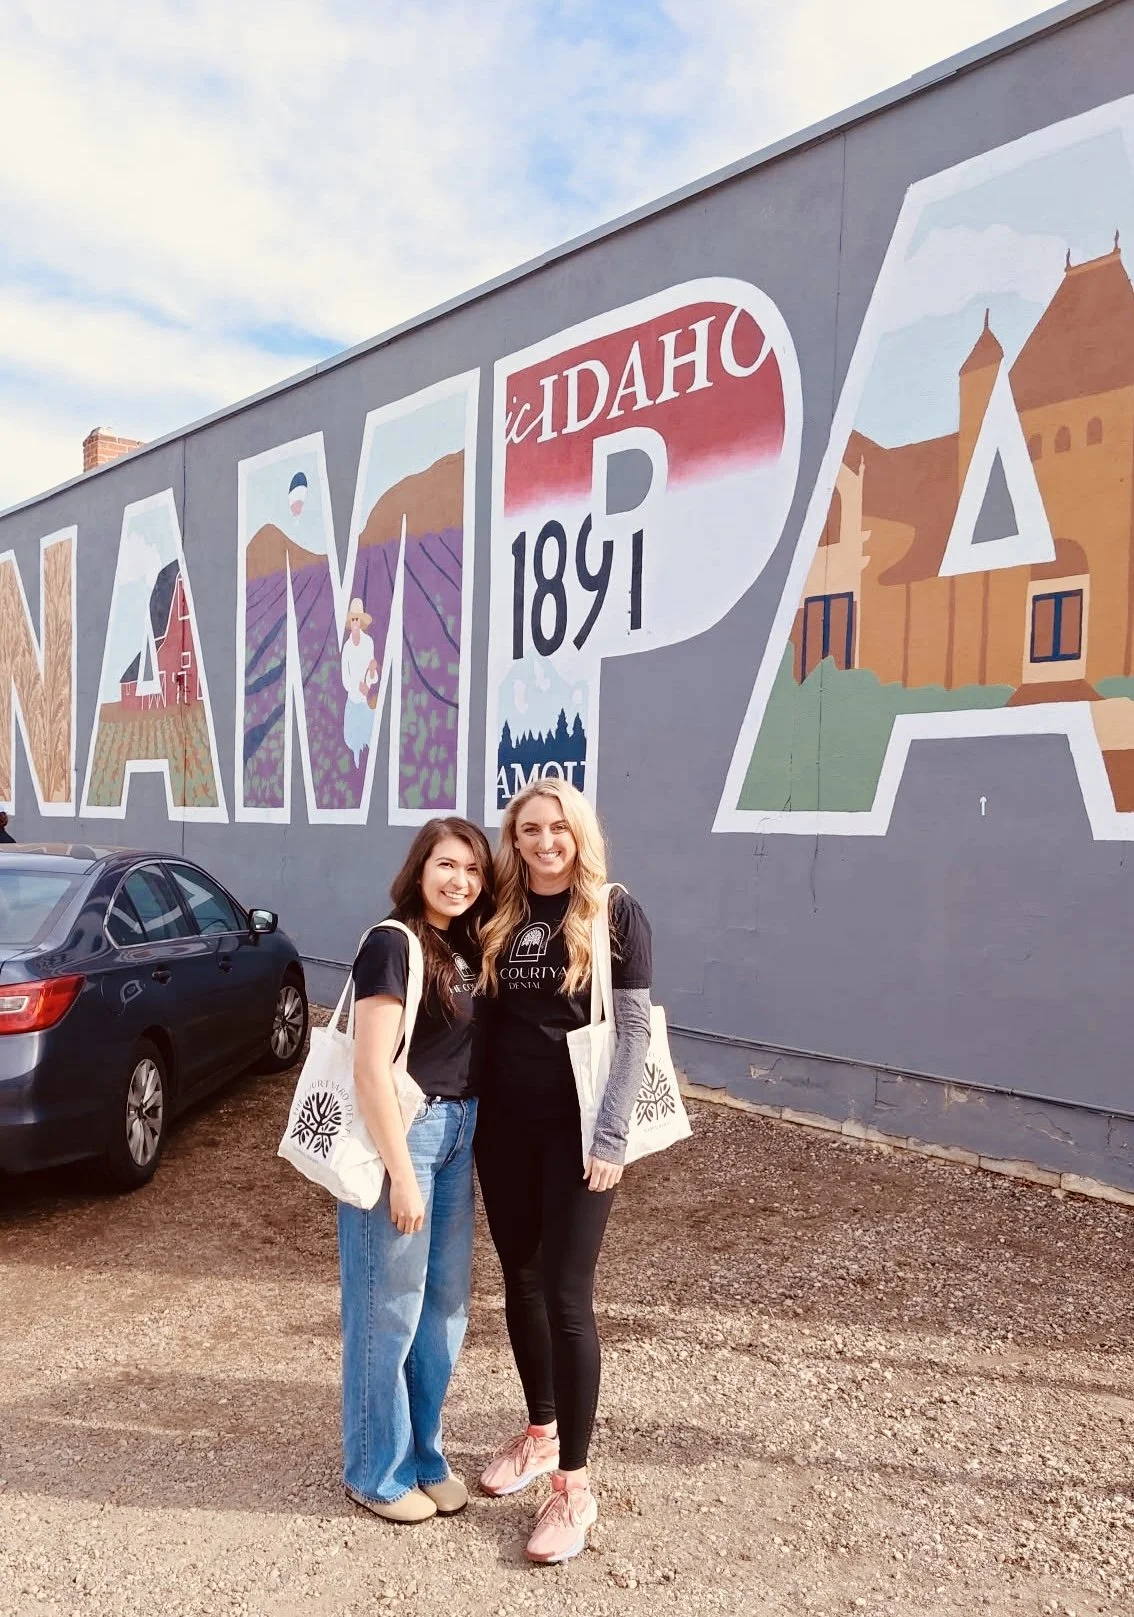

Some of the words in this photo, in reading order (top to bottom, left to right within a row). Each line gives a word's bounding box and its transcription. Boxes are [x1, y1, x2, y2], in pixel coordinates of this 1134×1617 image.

[537, 306, 773, 443] IDAHO
[0, 95, 1134, 841] NAMPA
[511, 513, 644, 661] 1891
